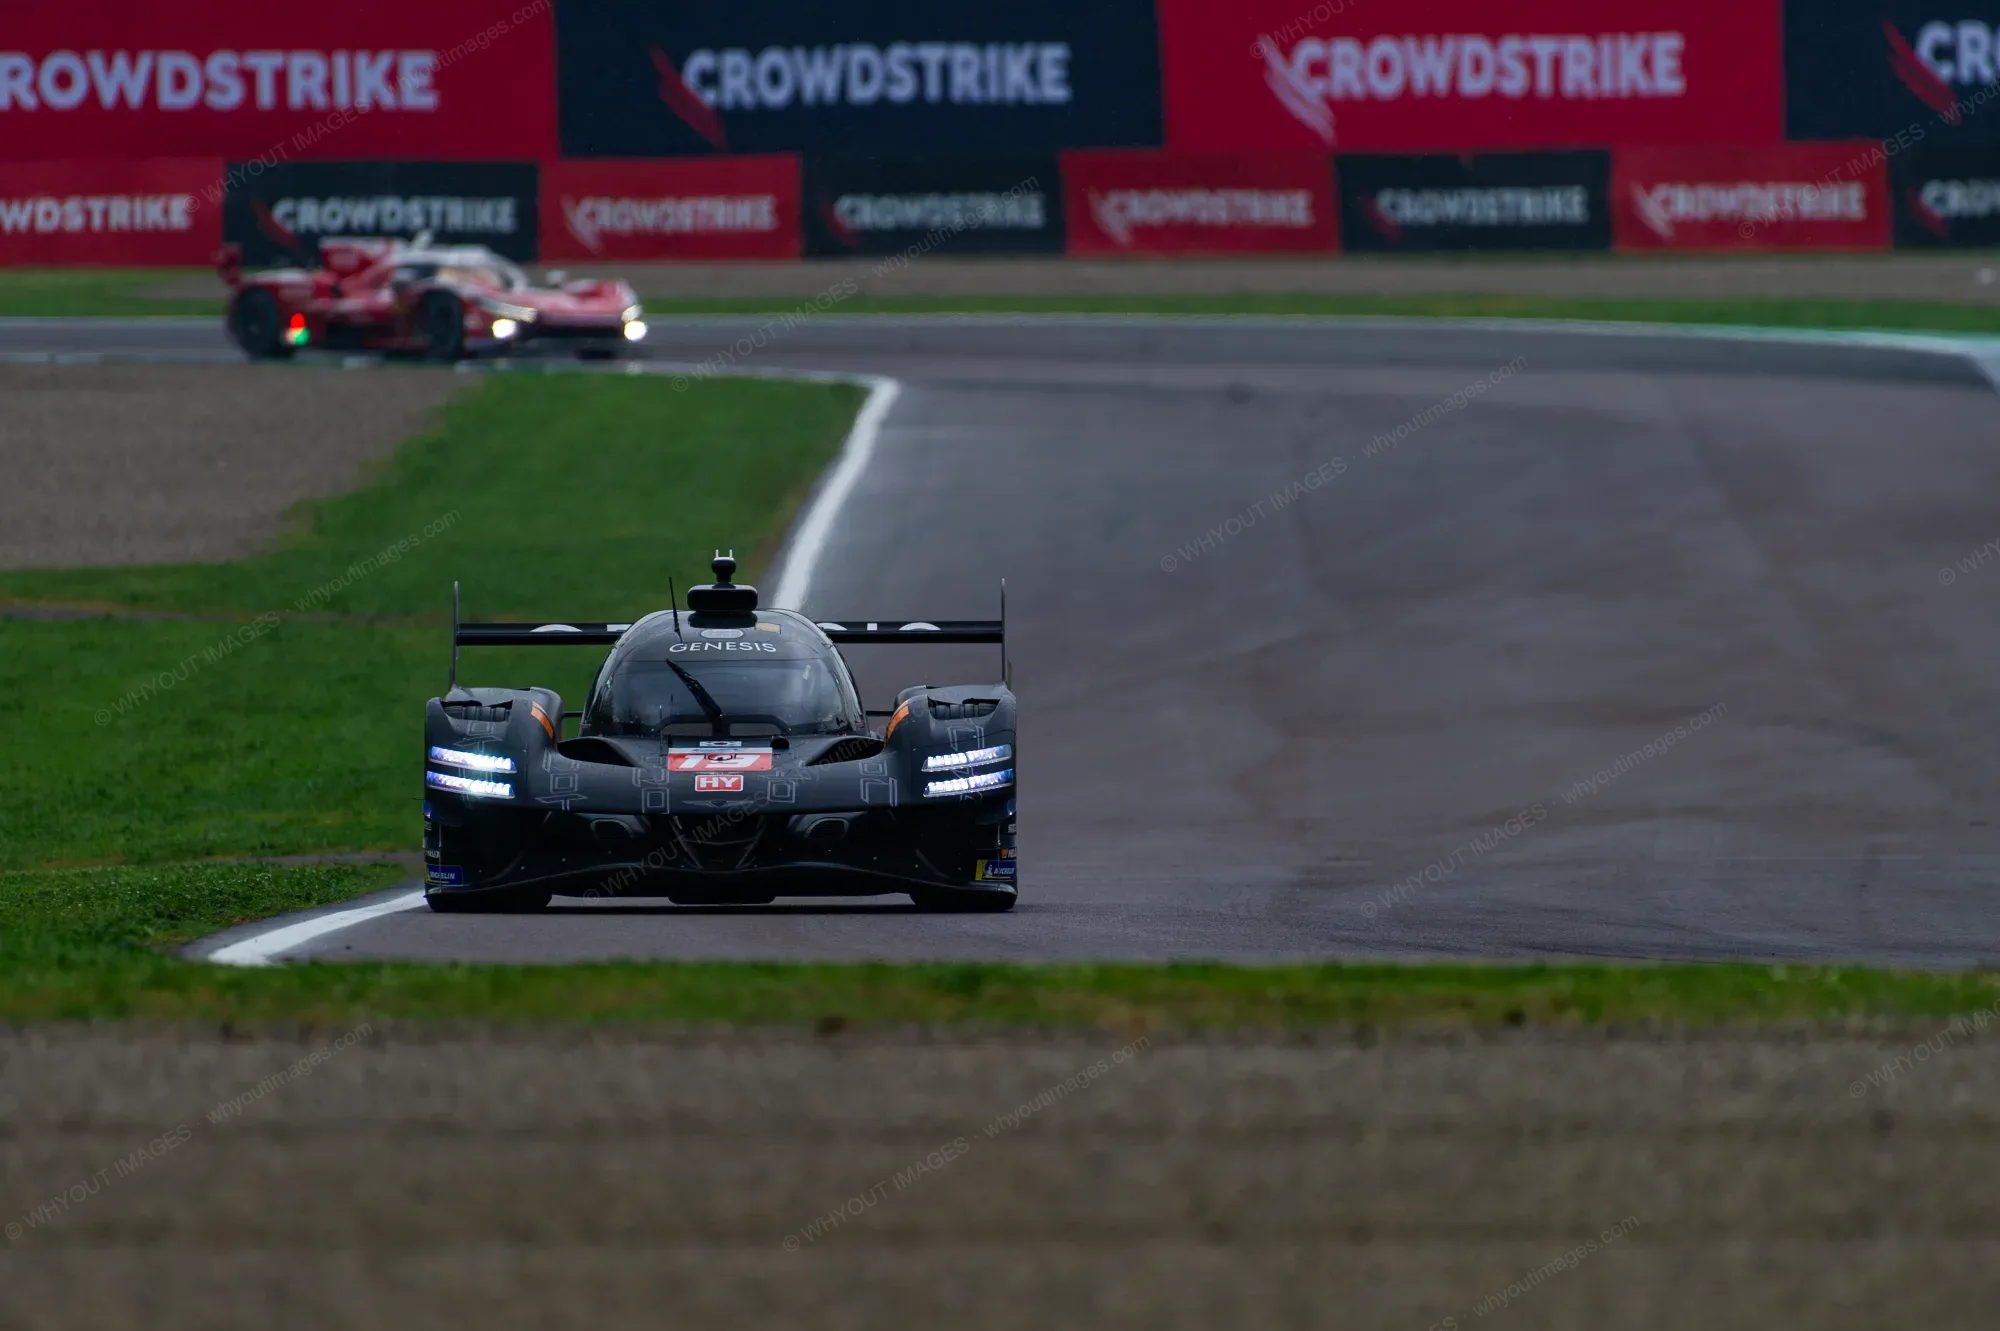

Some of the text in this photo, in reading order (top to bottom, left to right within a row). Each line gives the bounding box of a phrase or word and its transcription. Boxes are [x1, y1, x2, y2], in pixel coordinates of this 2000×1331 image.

[1294, 33, 1686, 99] CROWDSTRIKE
[1915, 20, 2000, 84] CR
[682, 42, 1071, 108] CROWDSTRIKE
[272, 196, 517, 234] CROWDSTRIKE
[576, 195, 776, 234] CROWDSTRIKE
[834, 192, 1045, 229] CROWDSTRIKE
[1106, 188, 1314, 227] CROWDSTRIKE
[1376, 186, 1588, 226] CROWDSTRIKE
[1651, 180, 1866, 221] CROWDSTRIKE
[669, 641, 777, 653] GENESIS
[699, 777, 739, 788] HY
